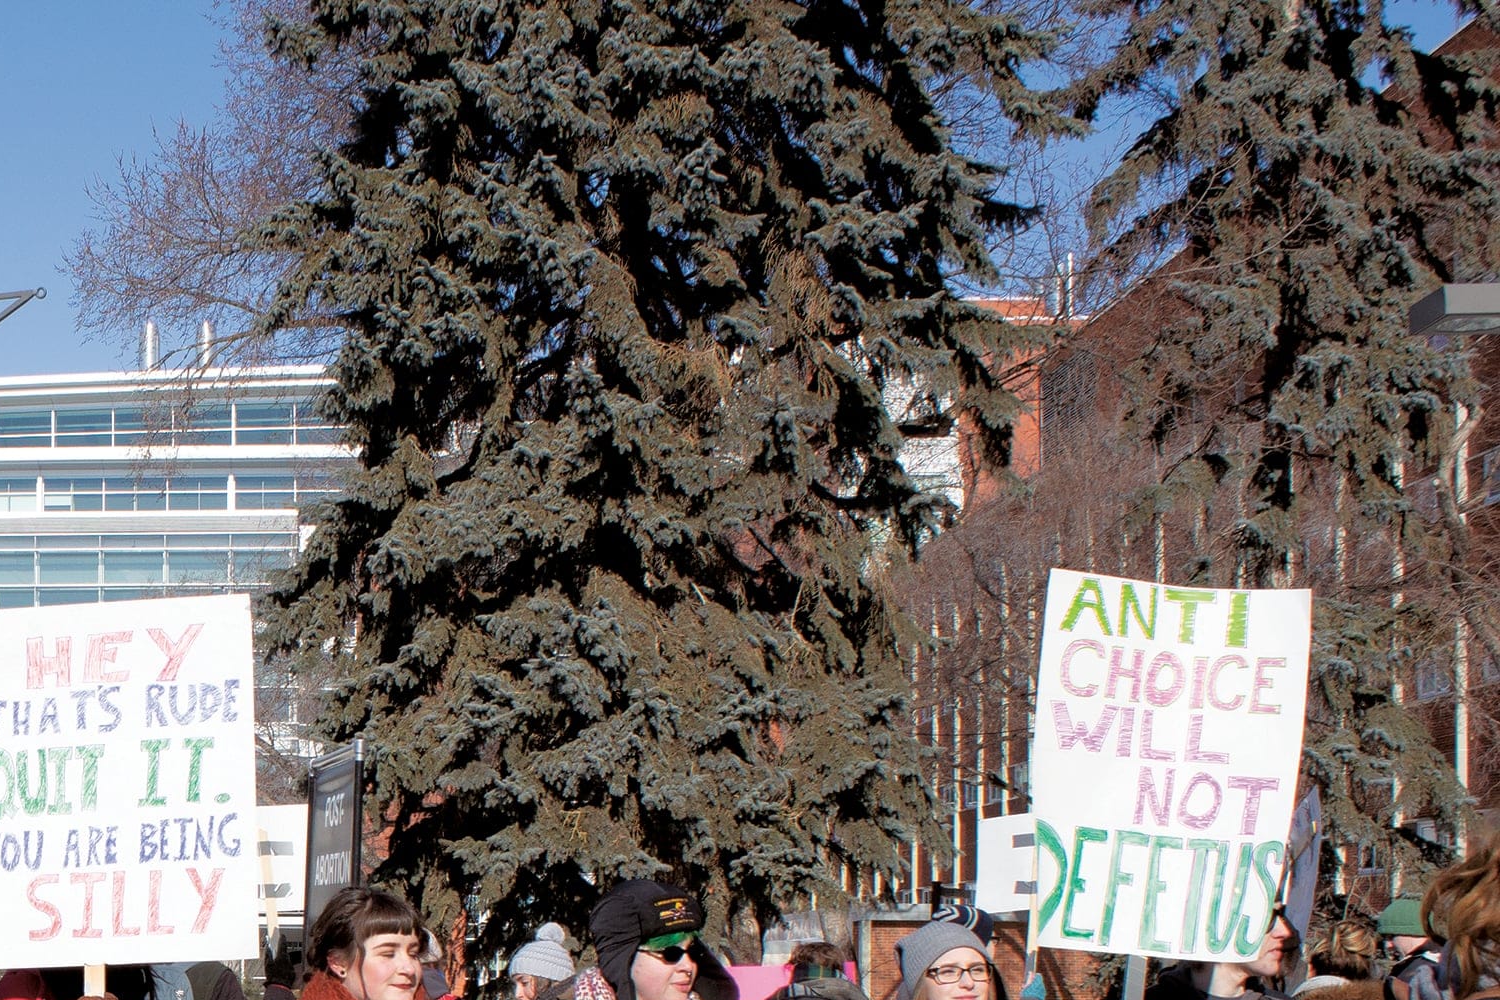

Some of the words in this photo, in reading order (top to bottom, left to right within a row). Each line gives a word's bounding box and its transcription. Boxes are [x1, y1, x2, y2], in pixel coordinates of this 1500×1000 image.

[1058, 577, 1251, 648] ANTI
[26, 623, 204, 689] HEY
[1059, 638, 1287, 715] CHOICE
[145, 678, 240, 728] RUDE
[1050, 700, 1230, 765] WILL
[138, 736, 231, 807] IT.
[1132, 765, 1280, 835] NOT
[63, 826, 119, 868] ARE
[139, 812, 242, 863] BEING
[315, 851, 351, 886] ABORTION
[26, 867, 226, 941] SILLY
[1035, 818, 1284, 958] DEFETUS
